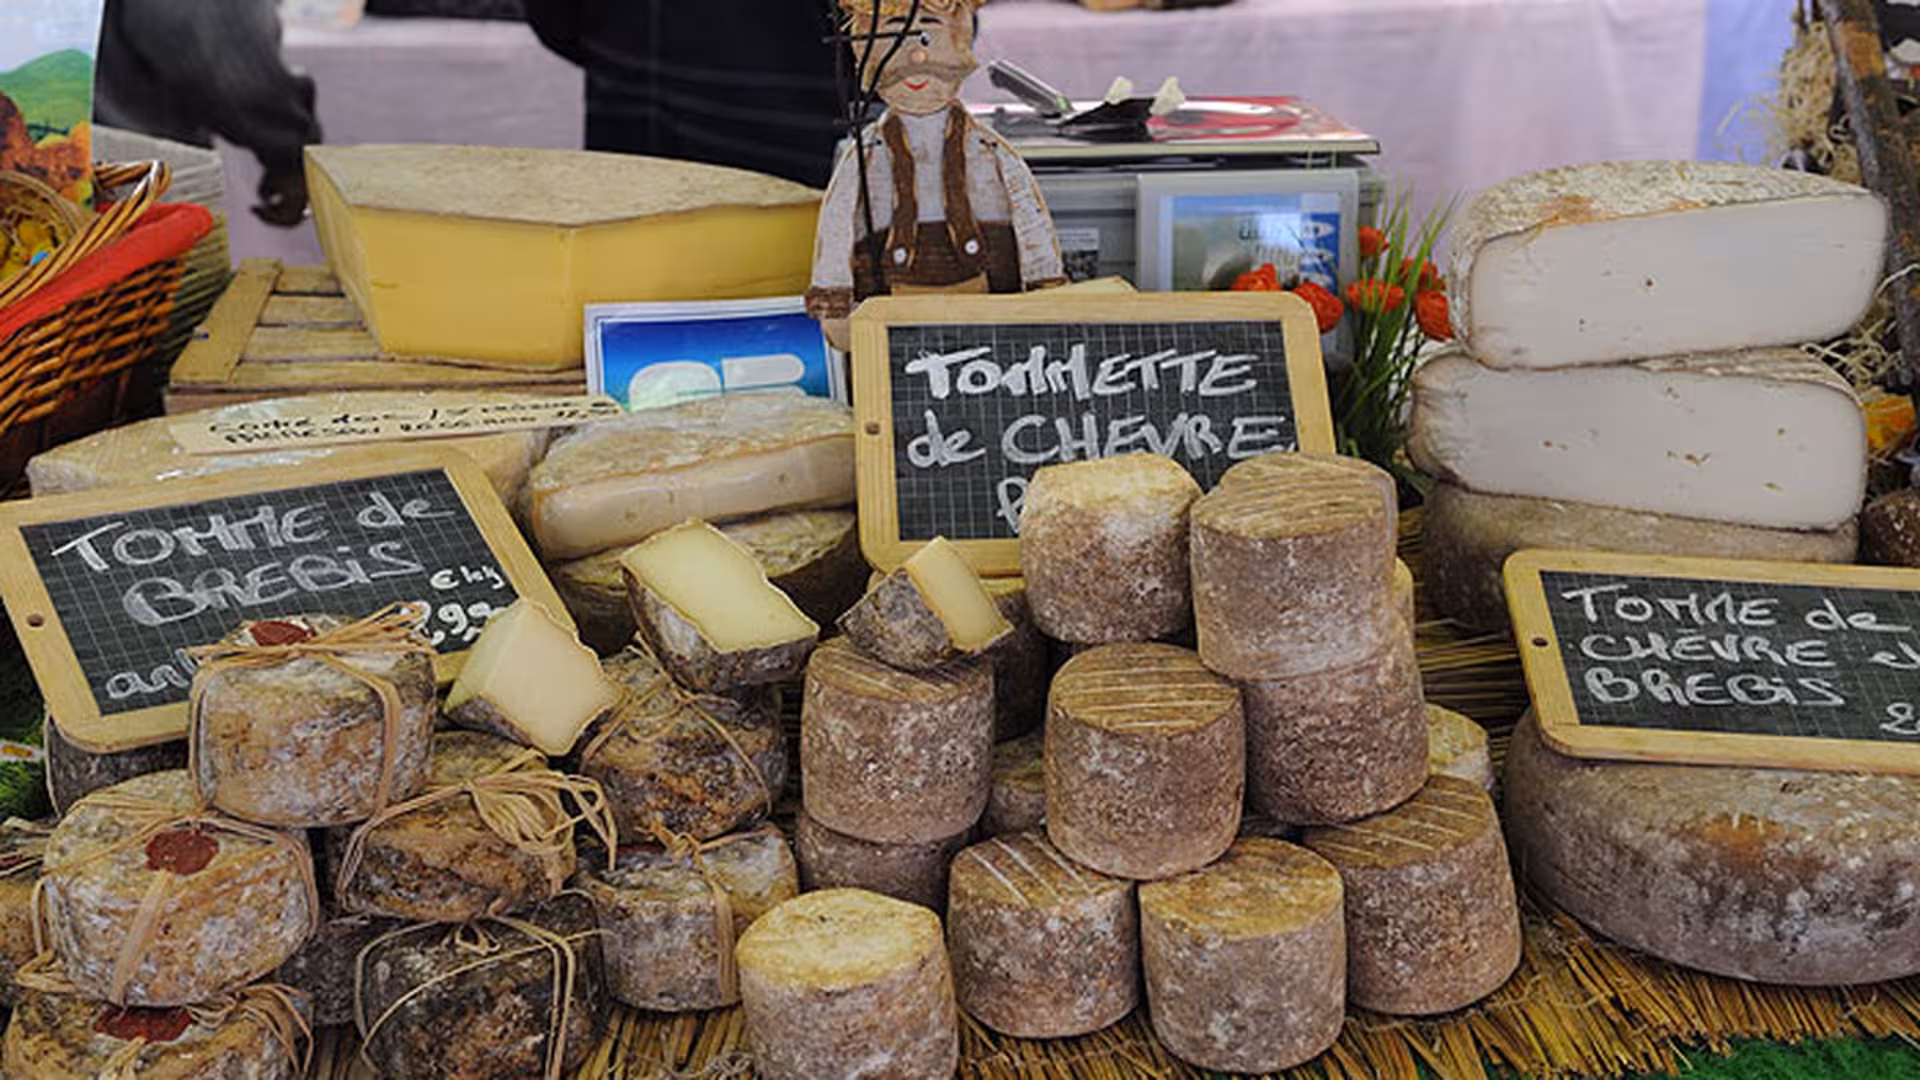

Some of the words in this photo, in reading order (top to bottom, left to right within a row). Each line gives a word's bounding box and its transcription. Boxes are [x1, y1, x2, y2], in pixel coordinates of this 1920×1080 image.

[905, 343, 1259, 400] TOMMETTE
[906, 409, 987, 468] de
[1001, 411, 1286, 464] CHEVRE
[51, 502, 327, 571] TOMME
[356, 492, 456, 529] de
[1561, 584, 1779, 626] TOMME
[1803, 599, 1911, 631] de
